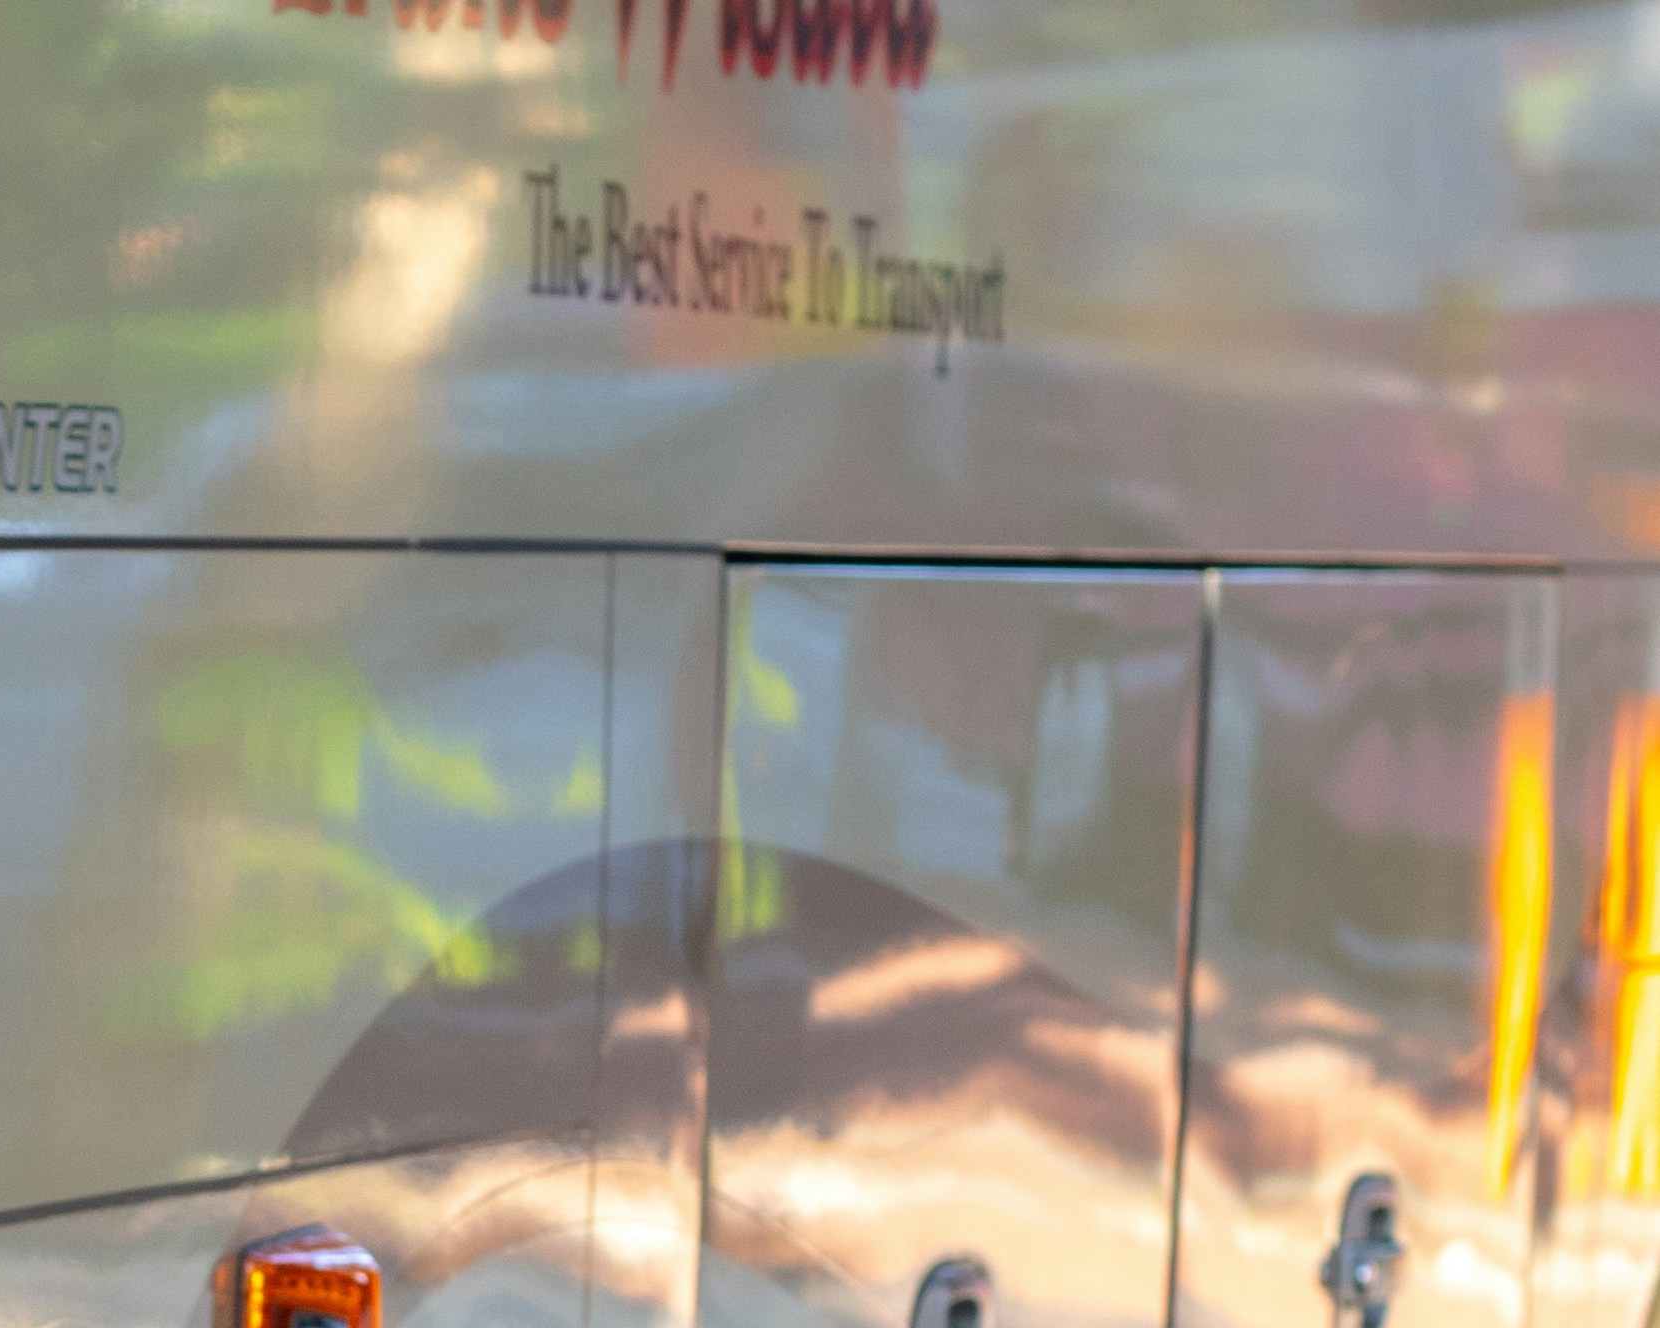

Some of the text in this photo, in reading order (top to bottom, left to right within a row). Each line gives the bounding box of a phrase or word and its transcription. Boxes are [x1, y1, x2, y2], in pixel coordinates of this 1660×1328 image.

[524, 162, 1005, 378] The Best Service To Transport
